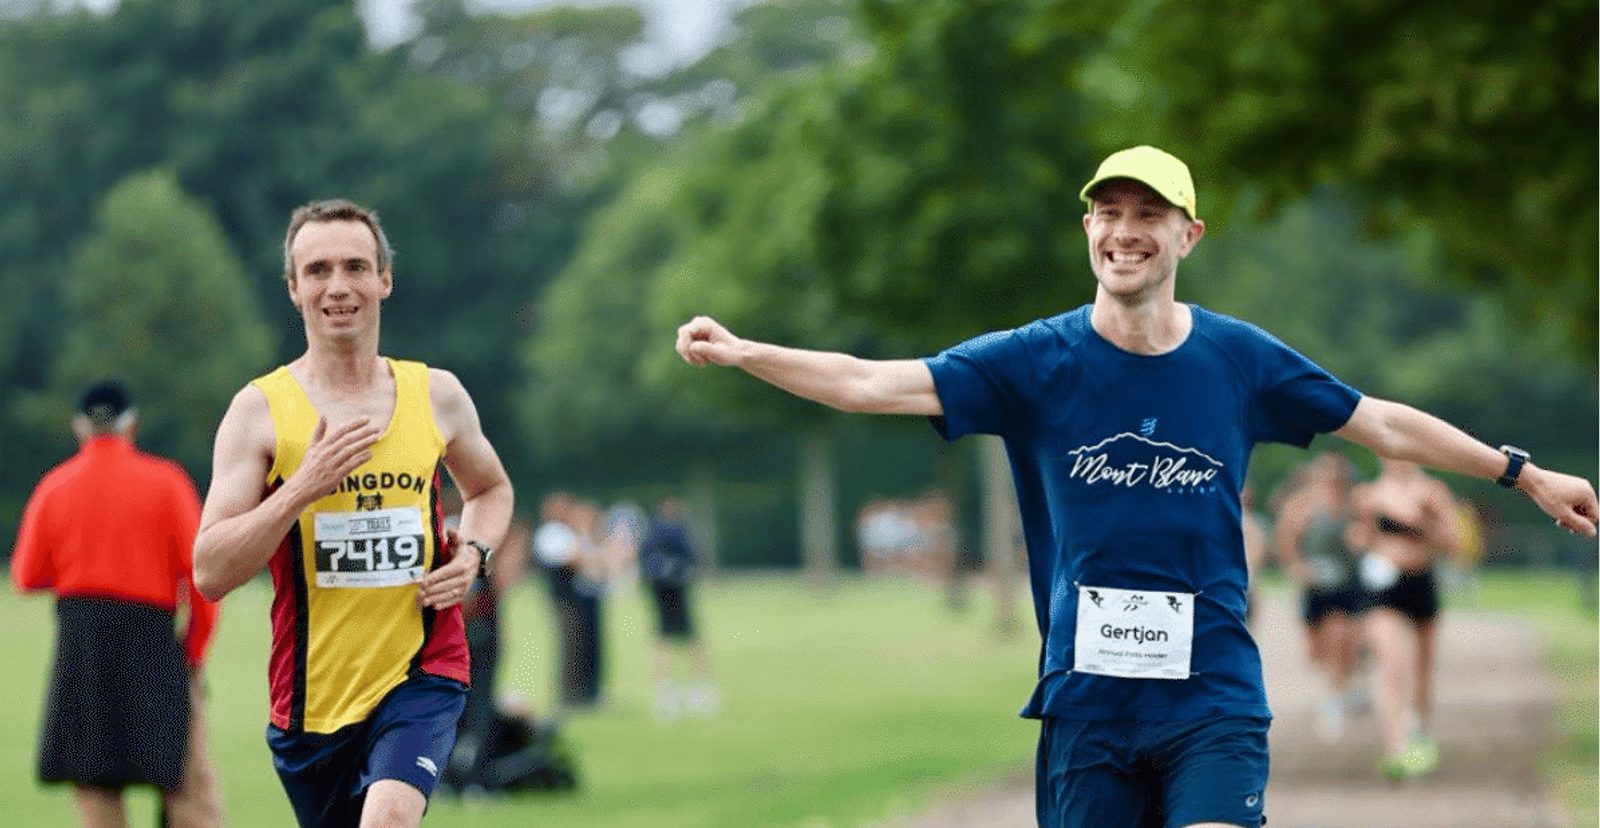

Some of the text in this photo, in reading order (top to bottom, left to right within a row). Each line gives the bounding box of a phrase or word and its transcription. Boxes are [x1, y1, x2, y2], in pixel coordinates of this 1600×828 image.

[1070, 453, 1217, 489] Mont Blanc
[321, 536, 419, 571] 7419
[1100, 623, 1169, 645] Gertjan
